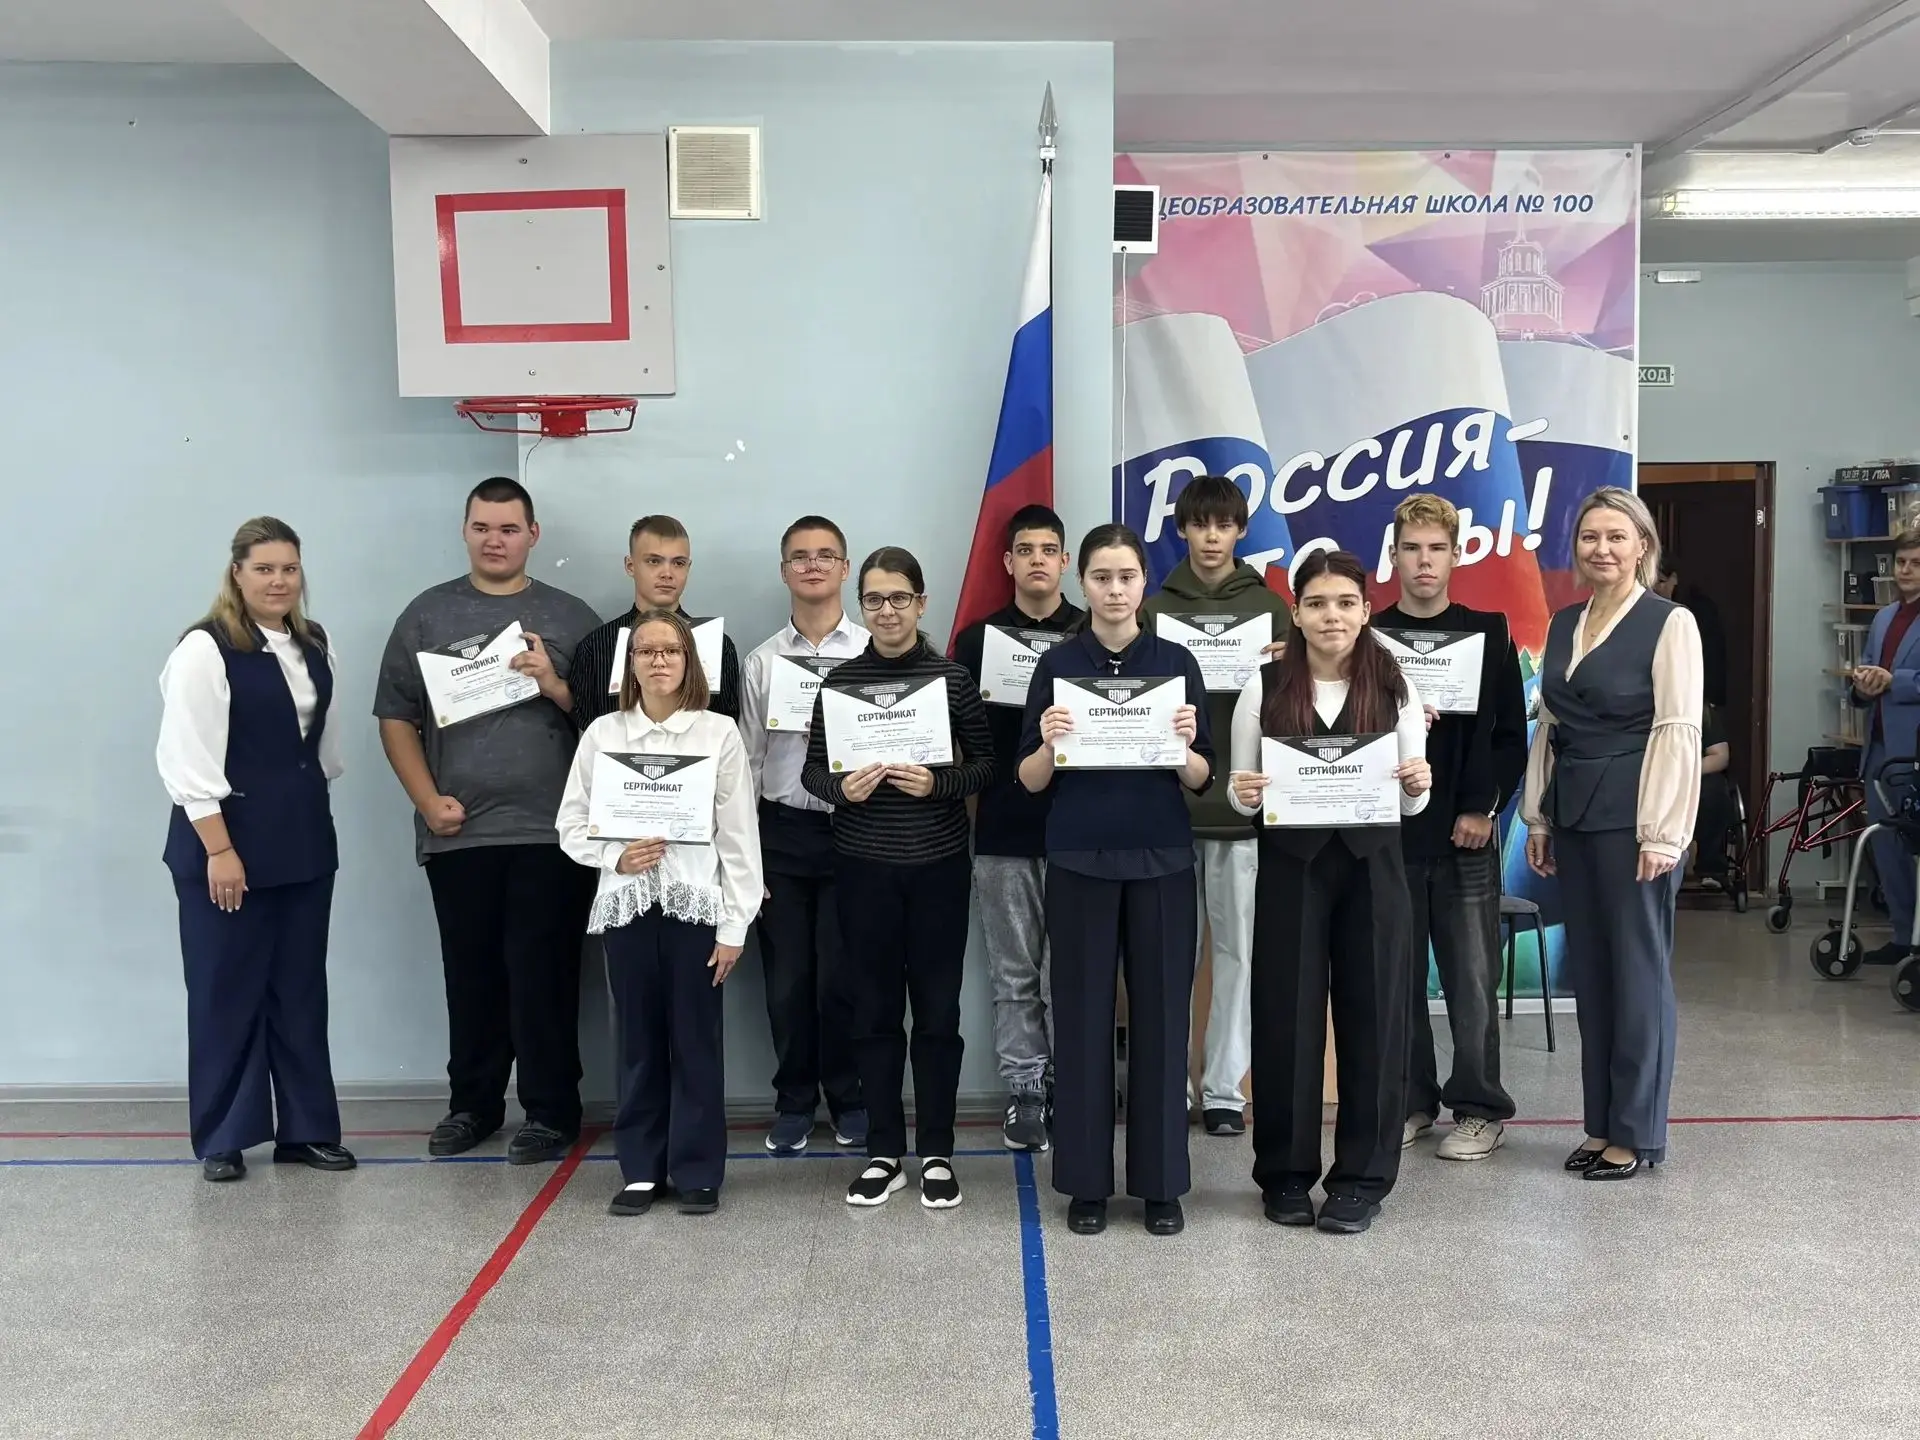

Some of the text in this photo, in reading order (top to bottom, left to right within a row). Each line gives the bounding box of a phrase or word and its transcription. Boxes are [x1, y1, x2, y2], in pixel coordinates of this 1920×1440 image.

[1424, 194, 1508, 215] ШКОЛА
[1515, 194, 1545, 214] №
[1552, 194, 1594, 213] 100
[1187, 638, 1242, 648] СЕРТИФИКАТ
[450, 654, 500, 677] СЕРТИФИКАТ
[1395, 656, 1452, 666] СЕРТИФИКАТ
[857, 708, 917, 723] СЕРТИФИКАТ
[1088, 706, 1152, 718] СЕРТИФИКАТ
[1298, 764, 1364, 776] СЕРТИФИКАТ
[623, 781, 684, 793] СЕРТИФИКАТ
